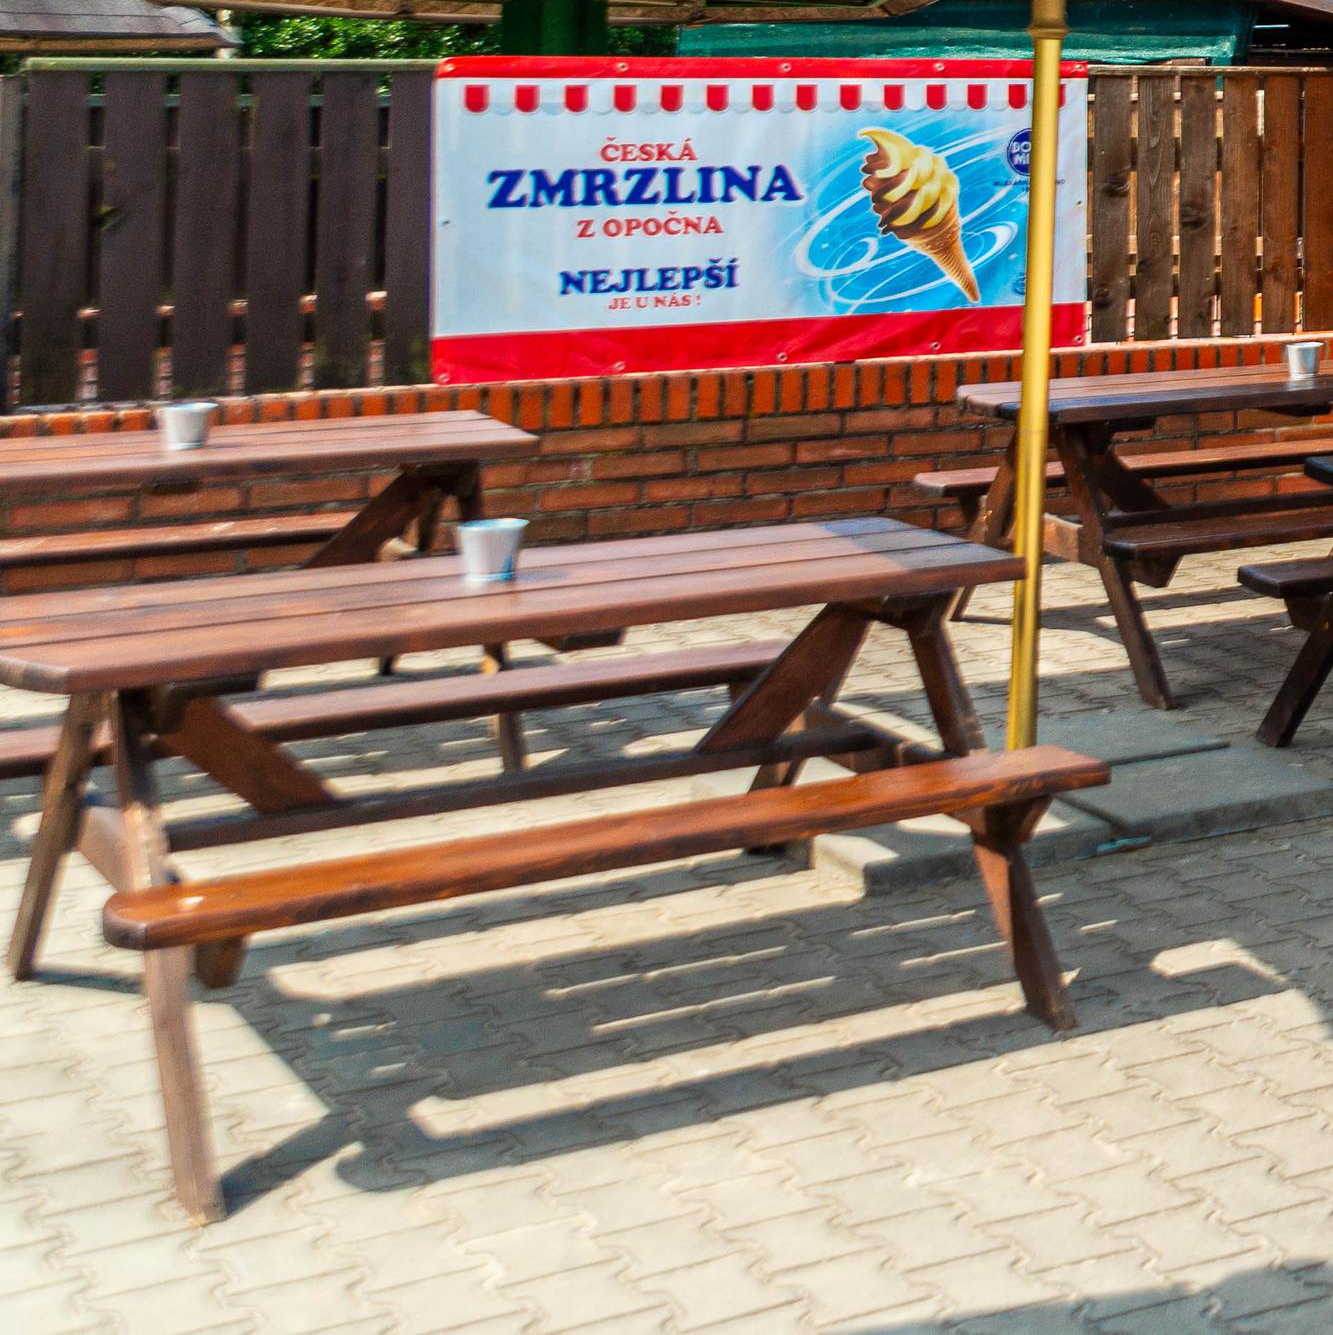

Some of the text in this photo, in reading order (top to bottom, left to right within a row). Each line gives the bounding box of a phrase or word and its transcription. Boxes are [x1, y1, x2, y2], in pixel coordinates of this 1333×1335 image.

[600, 136, 698, 163] ČESKÁ
[487, 164, 805, 209] ZMRZLINA
[577, 210, 724, 239] Z OPOČNA
[559, 257, 740, 296] NEJLEPŠÍ
[608, 293, 692, 311] JE U NÁS
